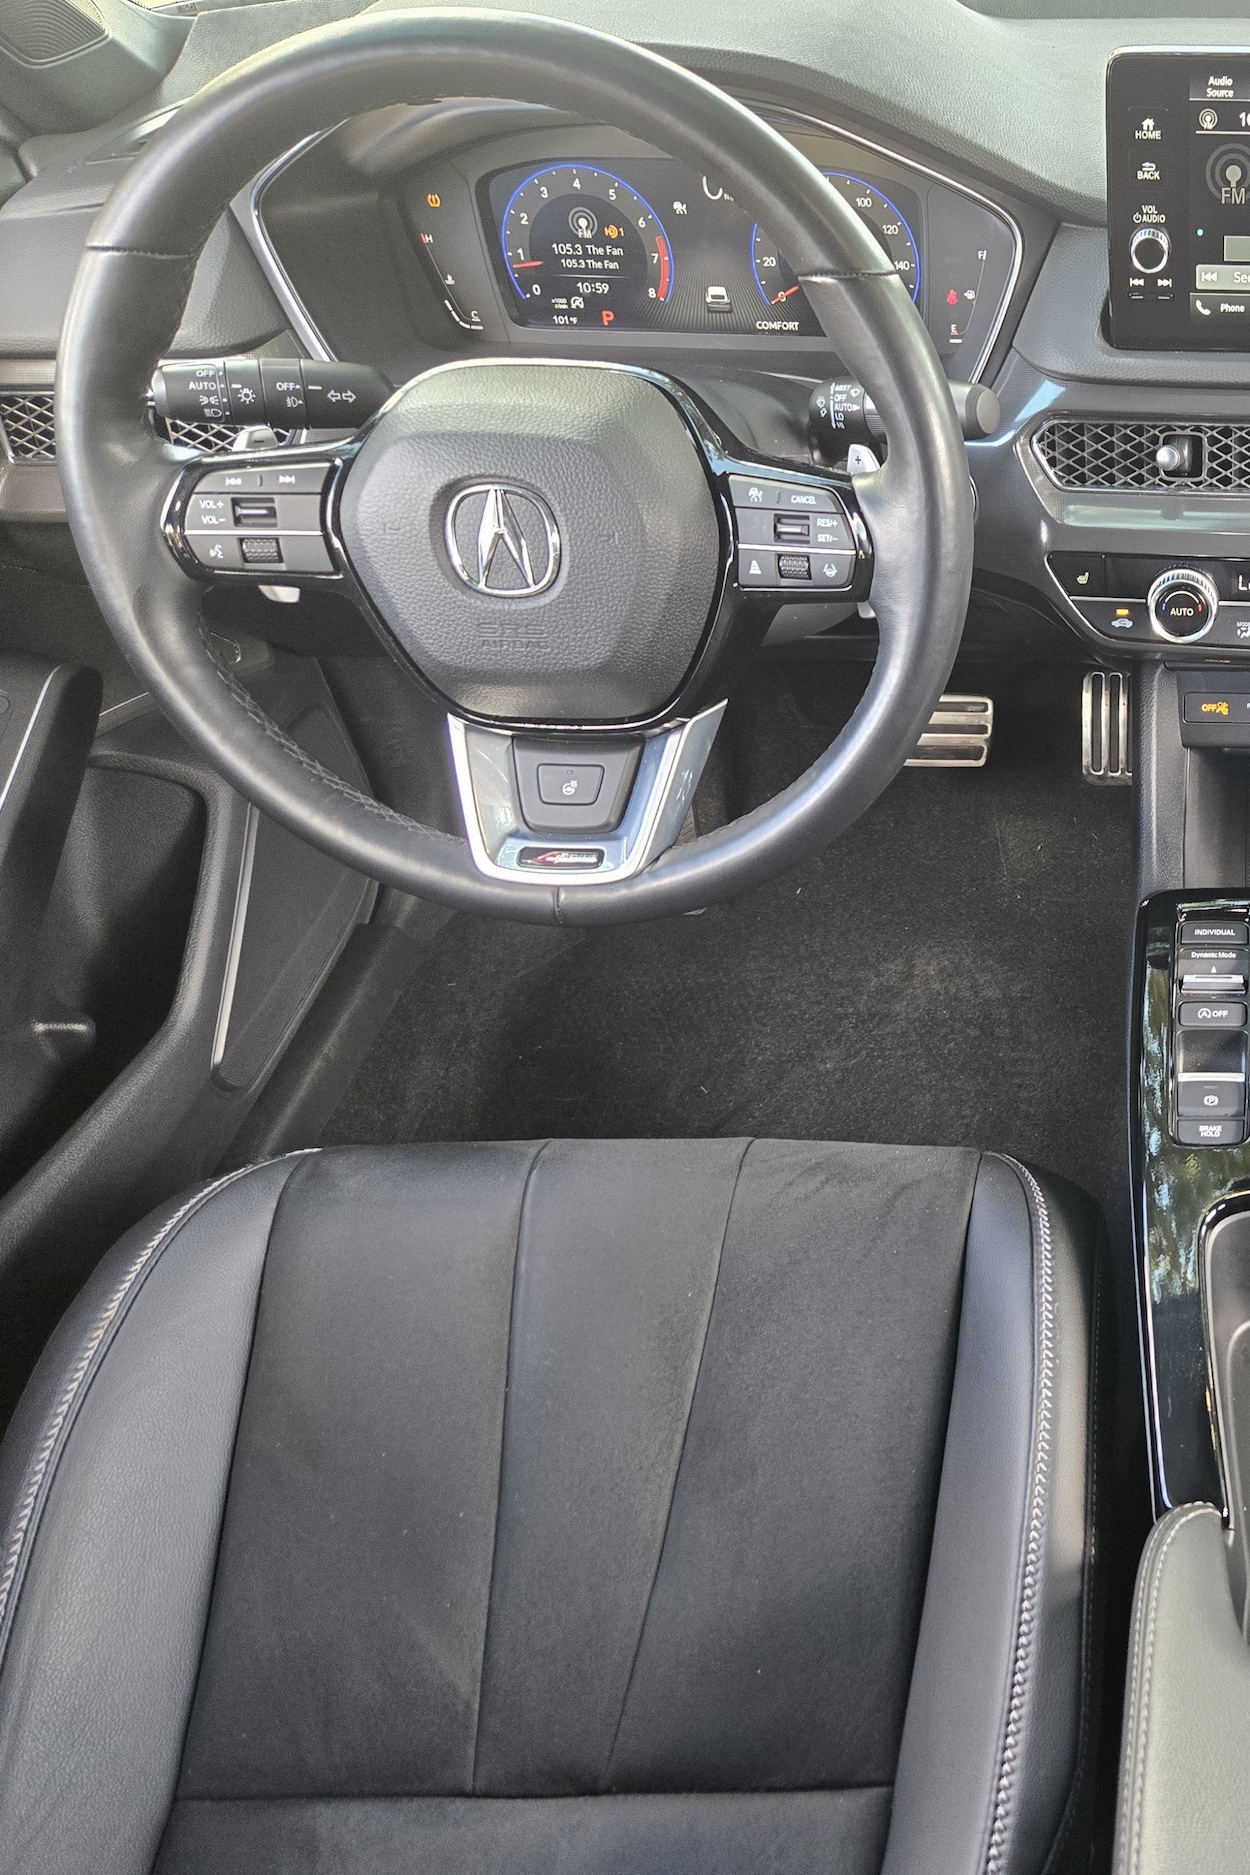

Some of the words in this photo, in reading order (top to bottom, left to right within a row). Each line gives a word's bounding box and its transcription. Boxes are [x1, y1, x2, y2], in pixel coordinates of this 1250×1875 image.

[1208, 76, 1233, 87] Audio
[1206, 88, 1234, 98] Source
[1135, 130, 1162, 140] HOME
[1137, 170, 1160, 180] BACK
[572, 178, 581, 190] 4
[540, 187, 549, 198] 3
[609, 189, 617, 200] 5
[1220, 187, 1246, 205] FM
[856, 197, 872, 208] 100
[1142, 205, 1158, 214] VOL
[519, 213, 529, 226] 2
[638, 217, 646, 228] 6
[1142, 214, 1166, 223] AUDIO
[882, 225, 899, 235] 120
[517, 248, 525, 260] 1
[552, 243, 583, 255] 105.3
[585, 244, 605, 256] The
[605, 245, 624, 256] Fan
[651, 253, 659, 264] 7
[763, 256, 777, 268] 20
[561, 259, 586, 269] 105.3
[587, 259, 603, 270] The
[604, 260, 619, 270] Fan
[893, 260, 911, 271] 140
[532, 284, 541, 296] 0
[577, 282, 610, 295] 10:59
[648, 287, 657, 299] 8
[1220, 303, 1245, 313] Phone
[602, 310, 615, 326] P
[756, 320, 799, 331] COMFORT
[189, 381, 216, 390] AUTO
[276, 382, 295, 391] OFF
[834, 394, 847, 402] OFF
[835, 403, 853, 411] AUTO
[791, 495, 816, 504] CANCEL
[816, 518, 838, 527] RES/+
[1170, 607, 1194, 617] AUTO
